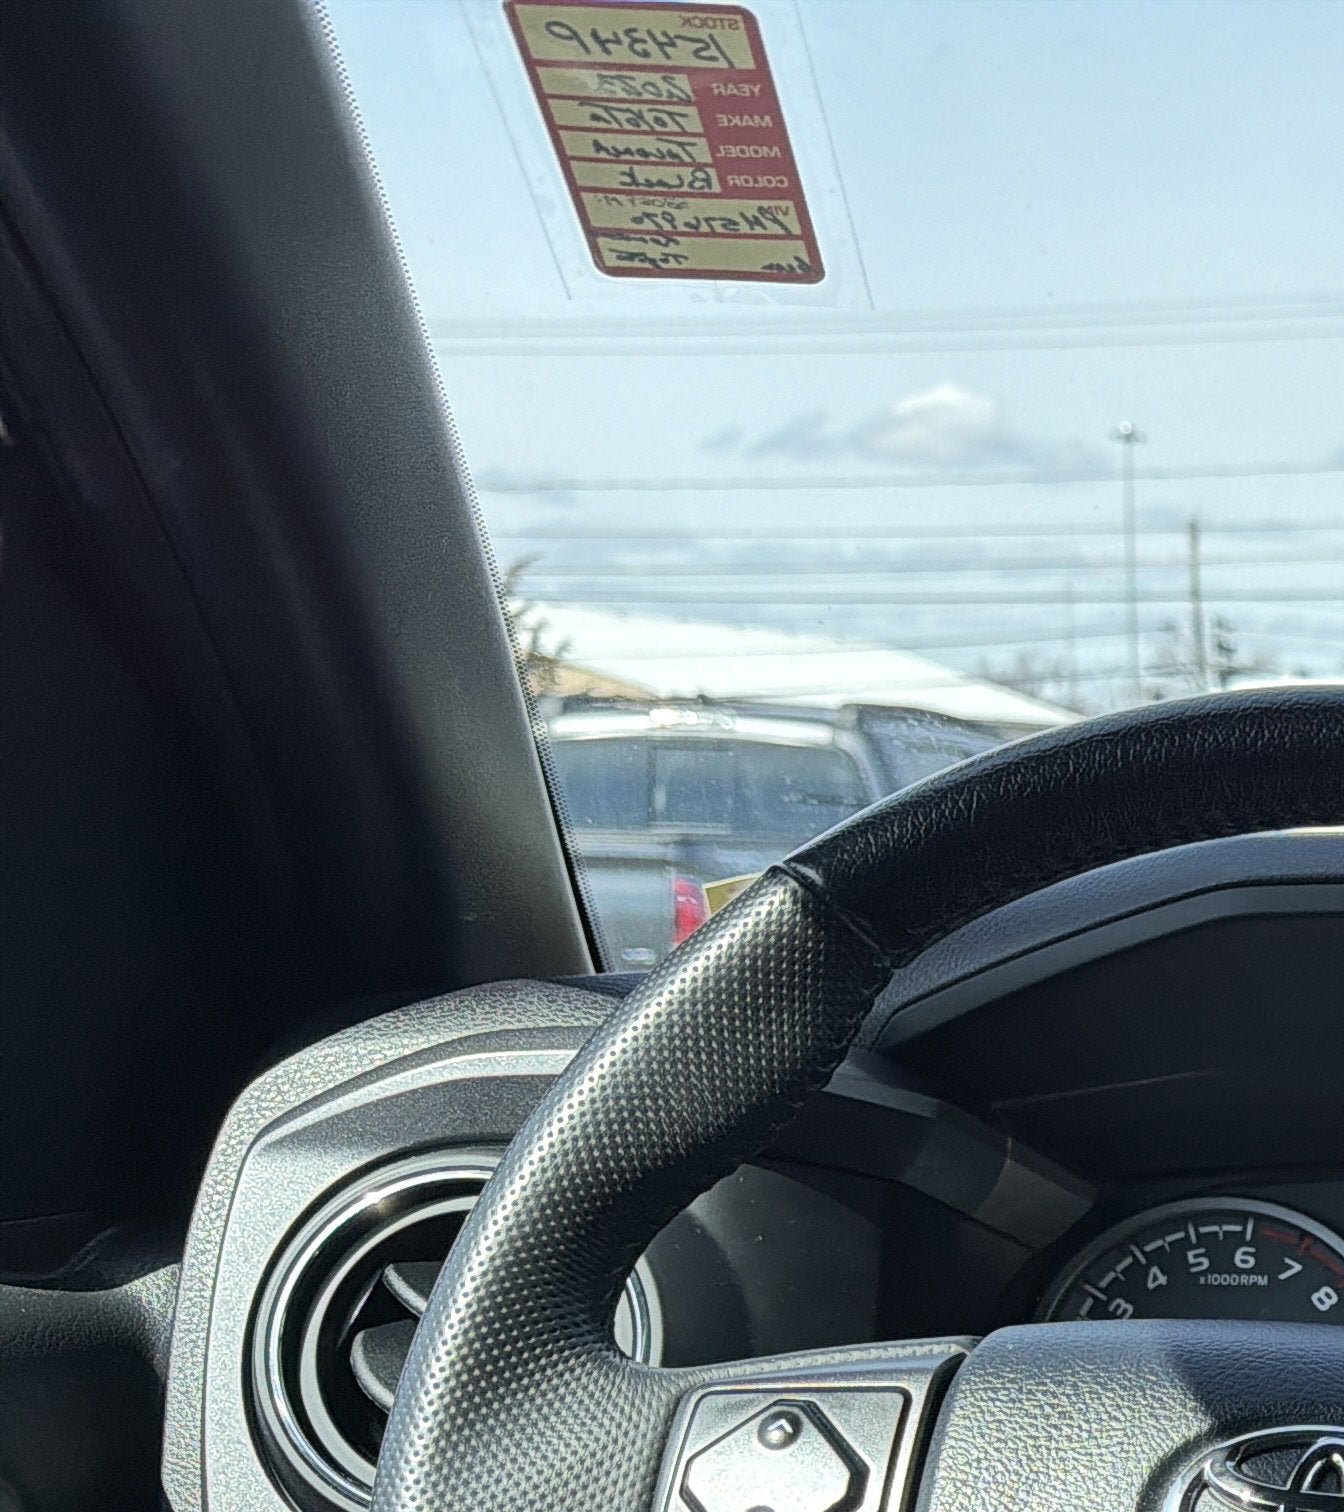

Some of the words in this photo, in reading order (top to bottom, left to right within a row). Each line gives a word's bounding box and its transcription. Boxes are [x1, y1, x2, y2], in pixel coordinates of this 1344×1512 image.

[1187, 1247, 1210, 1272] 5
[1234, 1246, 1256, 1269] 6
[1277, 1257, 1303, 1280] 7
[1147, 1265, 1168, 1290] 4
[1108, 1297, 1134, 1320] 3
[1311, 1285, 1339, 1312] 8
